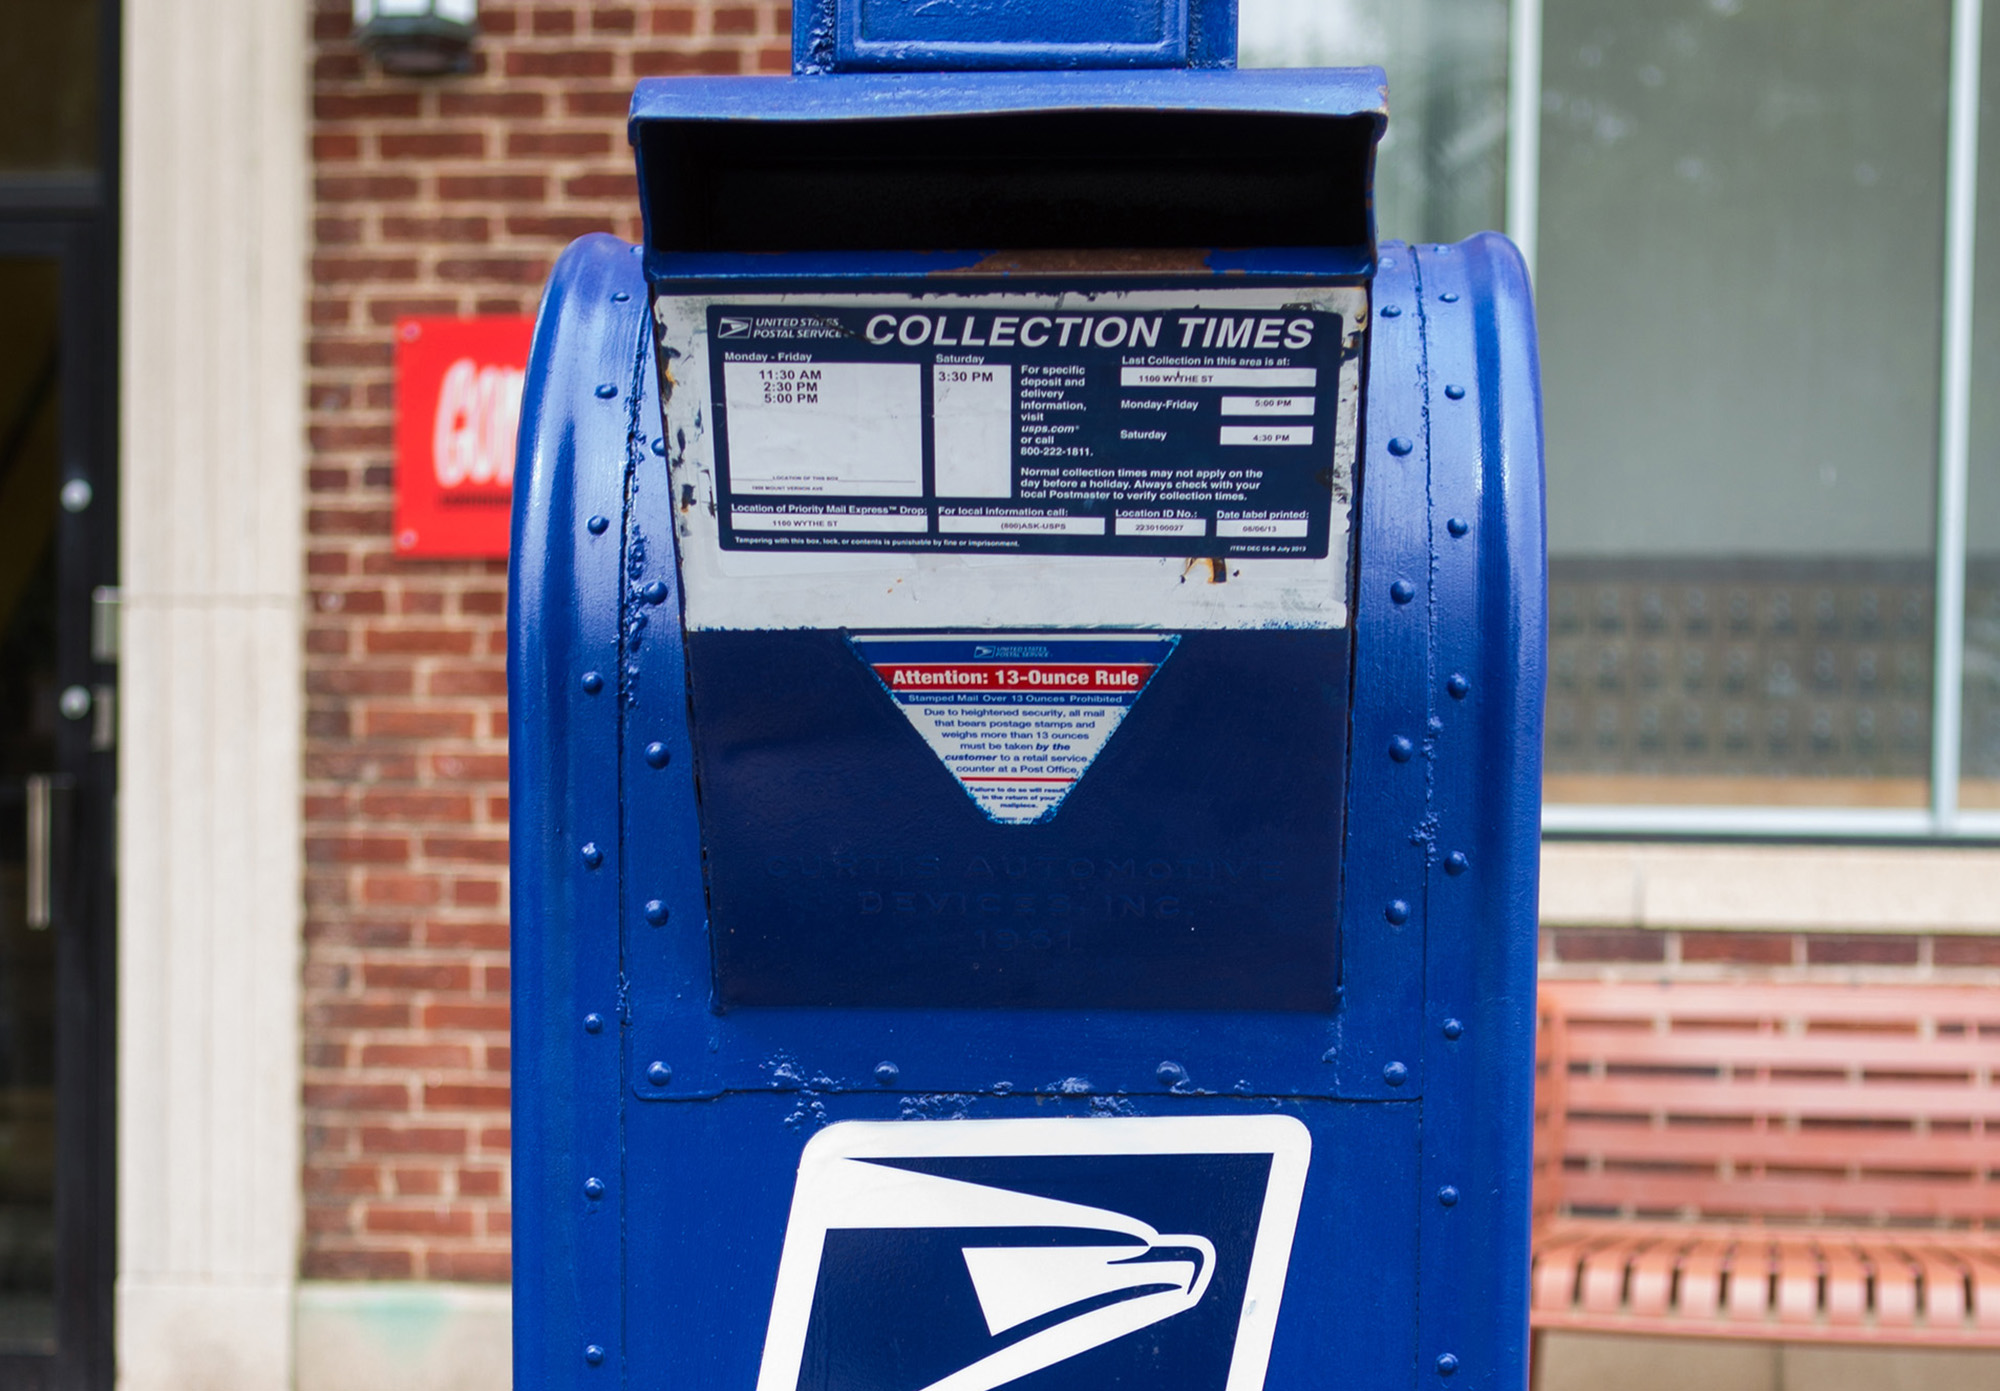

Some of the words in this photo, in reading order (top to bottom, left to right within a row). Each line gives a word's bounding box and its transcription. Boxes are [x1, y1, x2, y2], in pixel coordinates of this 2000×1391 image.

[755, 317, 799, 327] UNITED
[753, 329, 796, 338] POSTAL
[865, 314, 1162, 348] COLLECTION
[1177, 316, 1315, 349] TIMES
[724, 352, 768, 362] Monday
[778, 352, 812, 363] Friday
[936, 353, 985, 364] Saturday
[1121, 356, 1145, 366] Last
[1147, 356, 1201, 366] Collection
[1204, 356, 1214, 366] in
[1217, 356, 1236, 366] this
[1239, 358, 1262, 367] area
[1264, 357, 1274, 367] is
[1276, 357, 1290, 366] at:
[759, 370, 795, 380] 11:30
[799, 370, 822, 380] AM
[1021, 365, 1040, 375] For
[1042, 365, 1085, 376] specific
[938, 371, 968, 382] 3:30
[972, 371, 993, 382] PM
[1138, 375, 1160, 383] 1100
[1162, 372, 1199, 383] WYTHE
[1201, 375, 1214, 383] ST
[763, 381, 792, 392] 2:30
[796, 381, 818, 392] PM
[1020, 377, 1062, 388] deposit
[1064, 377, 1086, 387] and
[764, 393, 793, 404] 5:00
[797, 393, 818, 404] PM
[1020, 389, 1064, 400] delivery
[1020, 400, 1087, 411] information,
[1121, 399, 1199, 411] Monday-Friday
[1254, 399, 1275, 407] 5:00
[1276, 399, 1292, 407] PM
[1020, 412, 1044, 421] visit
[1020, 436, 1032, 444] or
[1035, 435, 1054, 444] call
[1120, 430, 1167, 441] Saturday
[1252, 434, 1273, 442] 4:30
[1275, 434, 1290, 442] PM
[1020, 447, 1093, 456] 800-222-1811.
[1020, 467, 1059, 478] Normal
[1062, 467, 1115, 478] collection
[1118, 468, 1147, 478] times
[1150, 470, 1173, 480] may
[1176, 469, 1194, 479] not
[1196, 469, 1226, 480] apply
[1229, 471, 1242, 479] on
[1245, 469, 1264, 479] the
[1020, 479, 1040, 489] day
[1043, 479, 1078, 488] before
[1089, 479, 1132, 490] holiday.
[1134, 480, 1173, 491] Always
[1175, 480, 1208, 490] check
[1210, 481, 1234, 490] with
[1235, 483, 1261, 491] your
[1020, 490, 1046, 498] local
[1049, 490, 1110, 499] Postmaster
[1113, 491, 1124, 499] to
[1126, 490, 1157, 501] verify
[1159, 491, 1213, 500] collection
[1215, 492, 1247, 501] times.
[731, 503, 774, 513] Location
[776, 504, 786, 513] of
[788, 504, 824, 515] Priority
[826, 505, 846, 513] Mail
[900, 506, 927, 515] Drop:
[938, 507, 956, 515] For
[958, 507, 983, 515] local
[985, 507, 1044, 516] information
[1046, 507, 1069, 516] call:
[1115, 509, 1160, 518] Location
[1162, 510, 1174, 518] ID
[1176, 510, 1197, 518] No.:
[1216, 510, 1240, 519] Date
[1242, 510, 1267, 519] label
[1269, 511, 1309, 520] printed:
[735, 536, 773, 545] Tampering
[774, 537, 790, 545] with
[892, 538, 932, 547] punishable
[933, 539, 942, 547] by
[892, 670, 989, 685] Attention:
[994, 670, 1089, 685] 13-Ounce
[1095, 670, 1139, 685] Rule
[908, 694, 954, 703] Stamped
[957, 694, 978, 702] Mail
[1025, 695, 1065, 703] Ounces
[1069, 695, 1123, 703] Prohibited
[924, 708, 945, 716] Due
[948, 708, 958, 716] to
[961, 708, 1019, 718] heightened
[1022, 709, 1066, 718] security,
[1068, 709, 1081, 717] all
[1084, 709, 1105, 717] mail
[934, 720, 955, 728] that
[957, 720, 987, 728] bears
[989, 720, 1032, 730] postage
[1034, 721, 1073, 730] stamps
[1075, 721, 1095, 729] and
[941, 731, 978, 740] weighs
[1010, 731, 1033, 739] than
[1051, 732, 1089, 740] ounces
[960, 742, 985, 750] must
[988, 742, 1002, 750] be
[1006, 742, 1034, 750] taken
[1035, 743, 1049, 752] by
[1052, 743, 1071, 751] the
[1022, 754, 1048, 762] retail
[956, 765, 995, 773] counter
[998, 765, 1008, 773] at
[1020, 765, 1044, 773] Post
